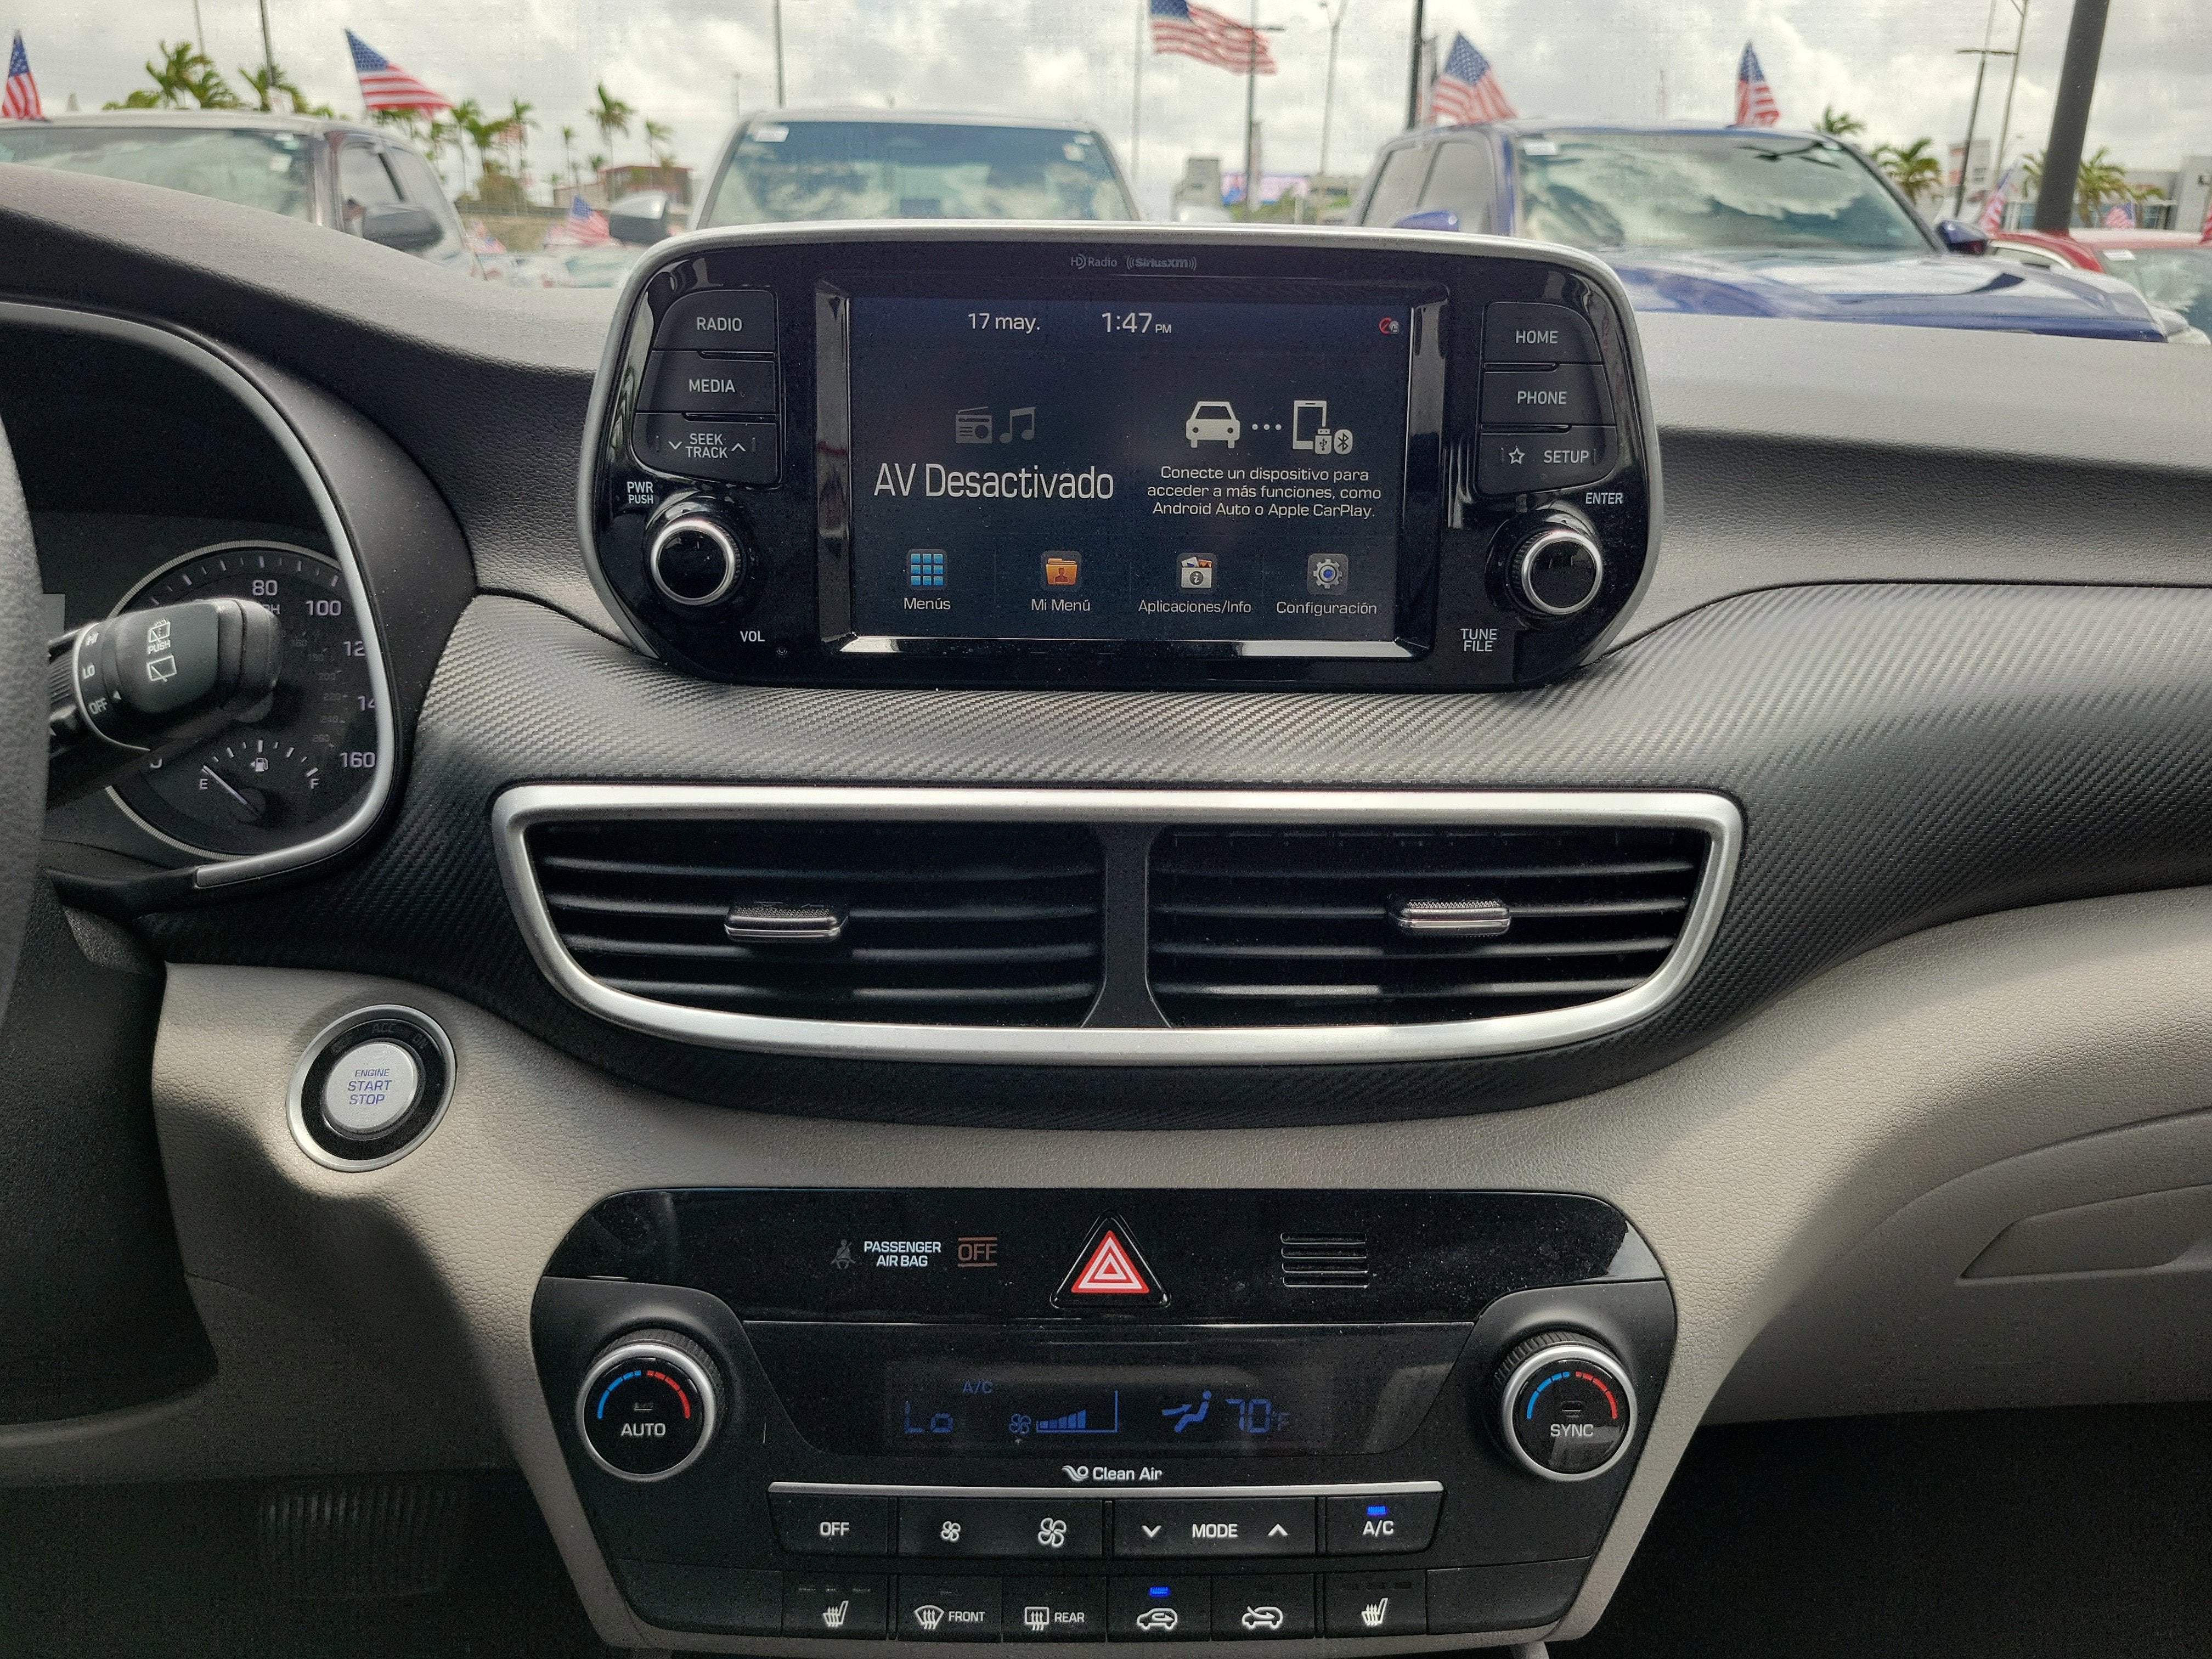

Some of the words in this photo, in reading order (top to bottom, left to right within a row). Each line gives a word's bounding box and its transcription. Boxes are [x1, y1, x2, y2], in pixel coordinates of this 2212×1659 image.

[1088, 256, 1118, 267] Radio
[696, 317, 742, 331] RADIO
[968, 313, 990, 329] 17
[995, 317, 1040, 334] may.
[1102, 312, 1153, 333] 1:47
[1155, 324, 1172, 334] PM
[1516, 330, 1559, 344] HOME
[689, 379, 735, 393] MEDIA
[1517, 391, 1567, 405] PHONE
[689, 432, 723, 445] SEEK
[685, 445, 728, 459] TRACK
[1543, 450, 1589, 464] SETUP
[874, 462, 916, 496] AV
[926, 463, 1114, 499] Desactivado
[1161, 466, 1224, 479] Conecte
[1227, 470, 1245, 479] un
[1249, 467, 1329, 483] dispositivo
[1333, 471, 1369, 483] para
[627, 481, 654, 493] PWR
[1147, 484, 1210, 497] acceder
[1212, 487, 1222, 497] a
[1226, 484, 1257, 498] más
[1260, 485, 1335, 500] funciones,
[1340, 489, 1381, 499] como
[628, 494, 654, 504] PUSH
[1585, 492, 1623, 505] ENTER
[1152, 501, 1211, 515] Android
[1215, 503, 1250, 515] Auto
[1255, 505, 1264, 516] o
[1268, 503, 1310, 518] Apple
[1313, 504, 1375, 520] CarPlay.
[252, 579, 278, 596] 80
[306, 600, 342, 616] 100
[904, 597, 951, 610] Menús
[1031, 599, 1047, 611] Mi
[1052, 599, 1091, 611] Menú
[1138, 600, 1251, 614] Aplicaciones/Info
[1276, 601, 1377, 616] Configuración
[86, 633, 99, 646] HI
[740, 630, 765, 642] VOL
[1460, 628, 1498, 640] TUNE
[148, 639, 171, 654] PUSH
[343, 641, 366, 657] 12
[1464, 640, 1493, 652] FILE
[82, 664, 95, 679] LO
[88, 697, 108, 714] OFF
[340, 752, 376, 768] 160
[199, 778, 208, 790] E
[310, 778, 319, 789] F
[354, 1069, 390, 1077] ENGINE
[347, 1080, 392, 1092] START
[348, 1093, 385, 1105] STOP
[864, 1240, 941, 1253] PASSENGER
[958, 1243, 997, 1261] OFF
[876, 1255, 899, 1267] AIR
[900, 1255, 928, 1267] BAG
[962, 1380, 994, 1395] A/C
[620, 1423, 666, 1437] AUTO
[1550, 1424, 1594, 1438] SYNC
[1092, 1466, 1135, 1481] Clean
[1139, 1466, 1163, 1481] Air
[820, 1521, 850, 1537] OFF
[1192, 1523, 1238, 1538] MODE
[1363, 1520, 1394, 1537] A/C
[948, 1611, 985, 1622] FRONT
[1054, 1612, 1085, 1623] REAR
